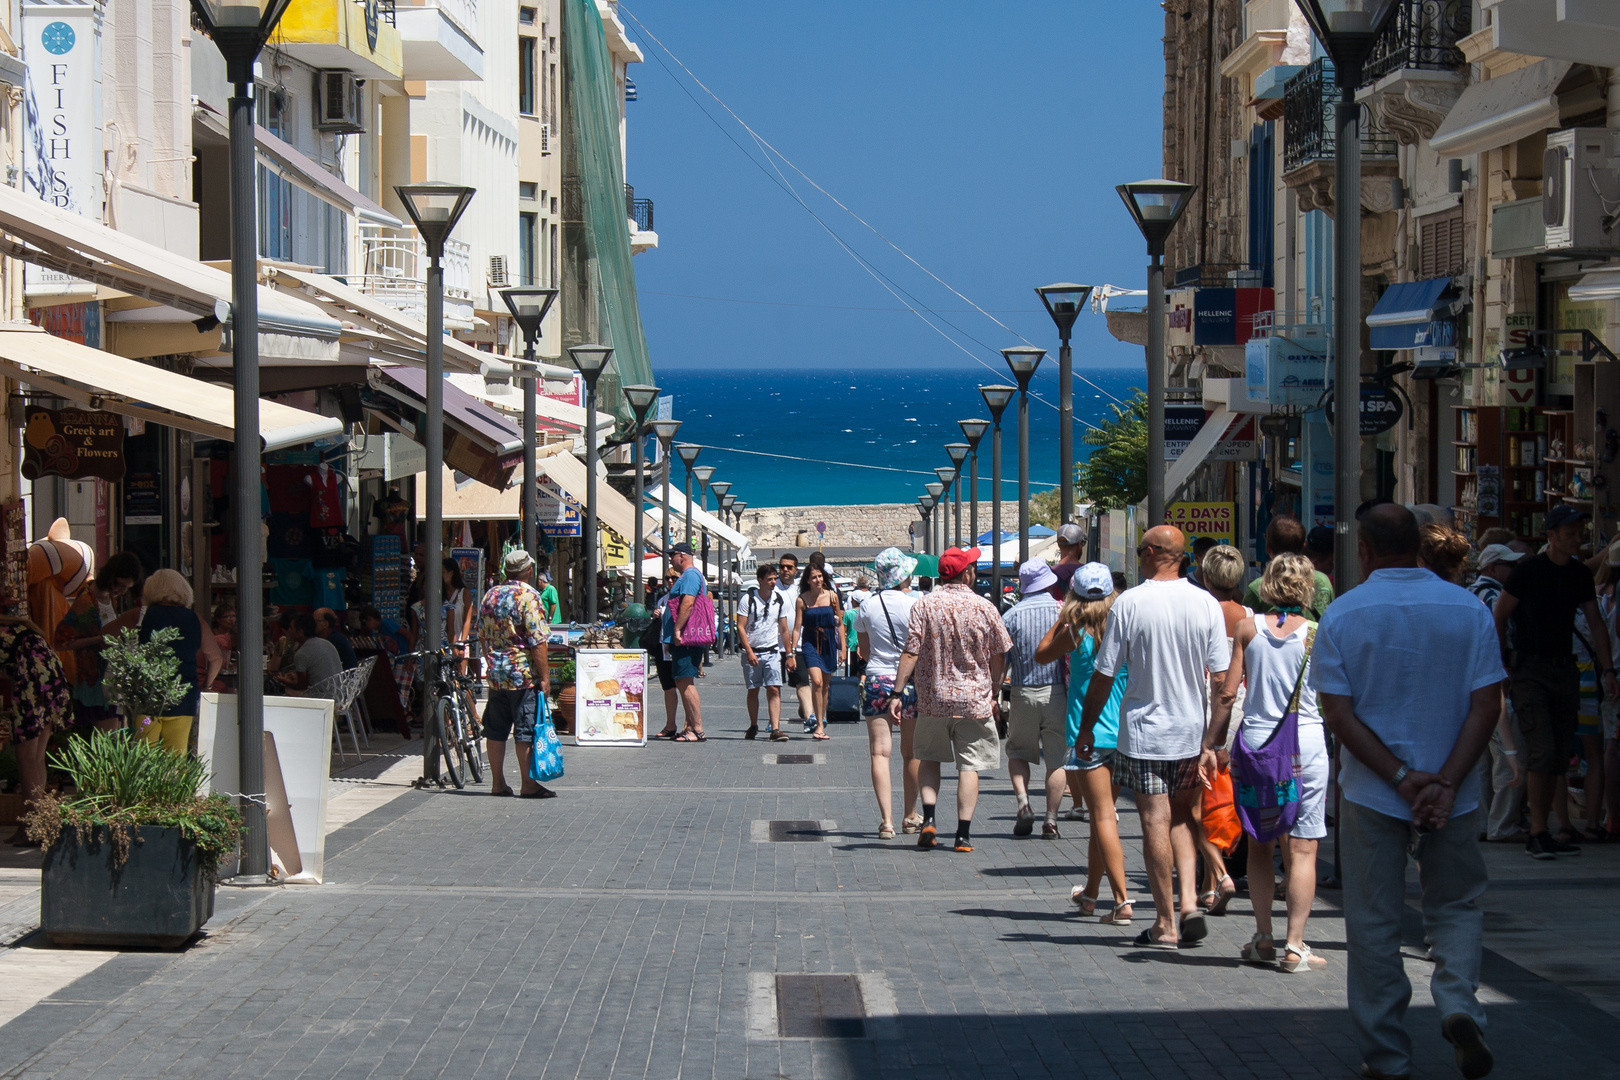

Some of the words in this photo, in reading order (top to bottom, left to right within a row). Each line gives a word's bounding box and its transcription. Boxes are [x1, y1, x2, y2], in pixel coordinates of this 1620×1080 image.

[1367, 400, 1397, 412] SPA
[63, 425, 96, 436] Greek
[98, 428, 115, 437] art
[83, 437, 93, 446] &
[77, 447, 119, 458] Flowers
[1177, 508, 1186, 519] 2
[1191, 507, 1231, 519] DAYS
